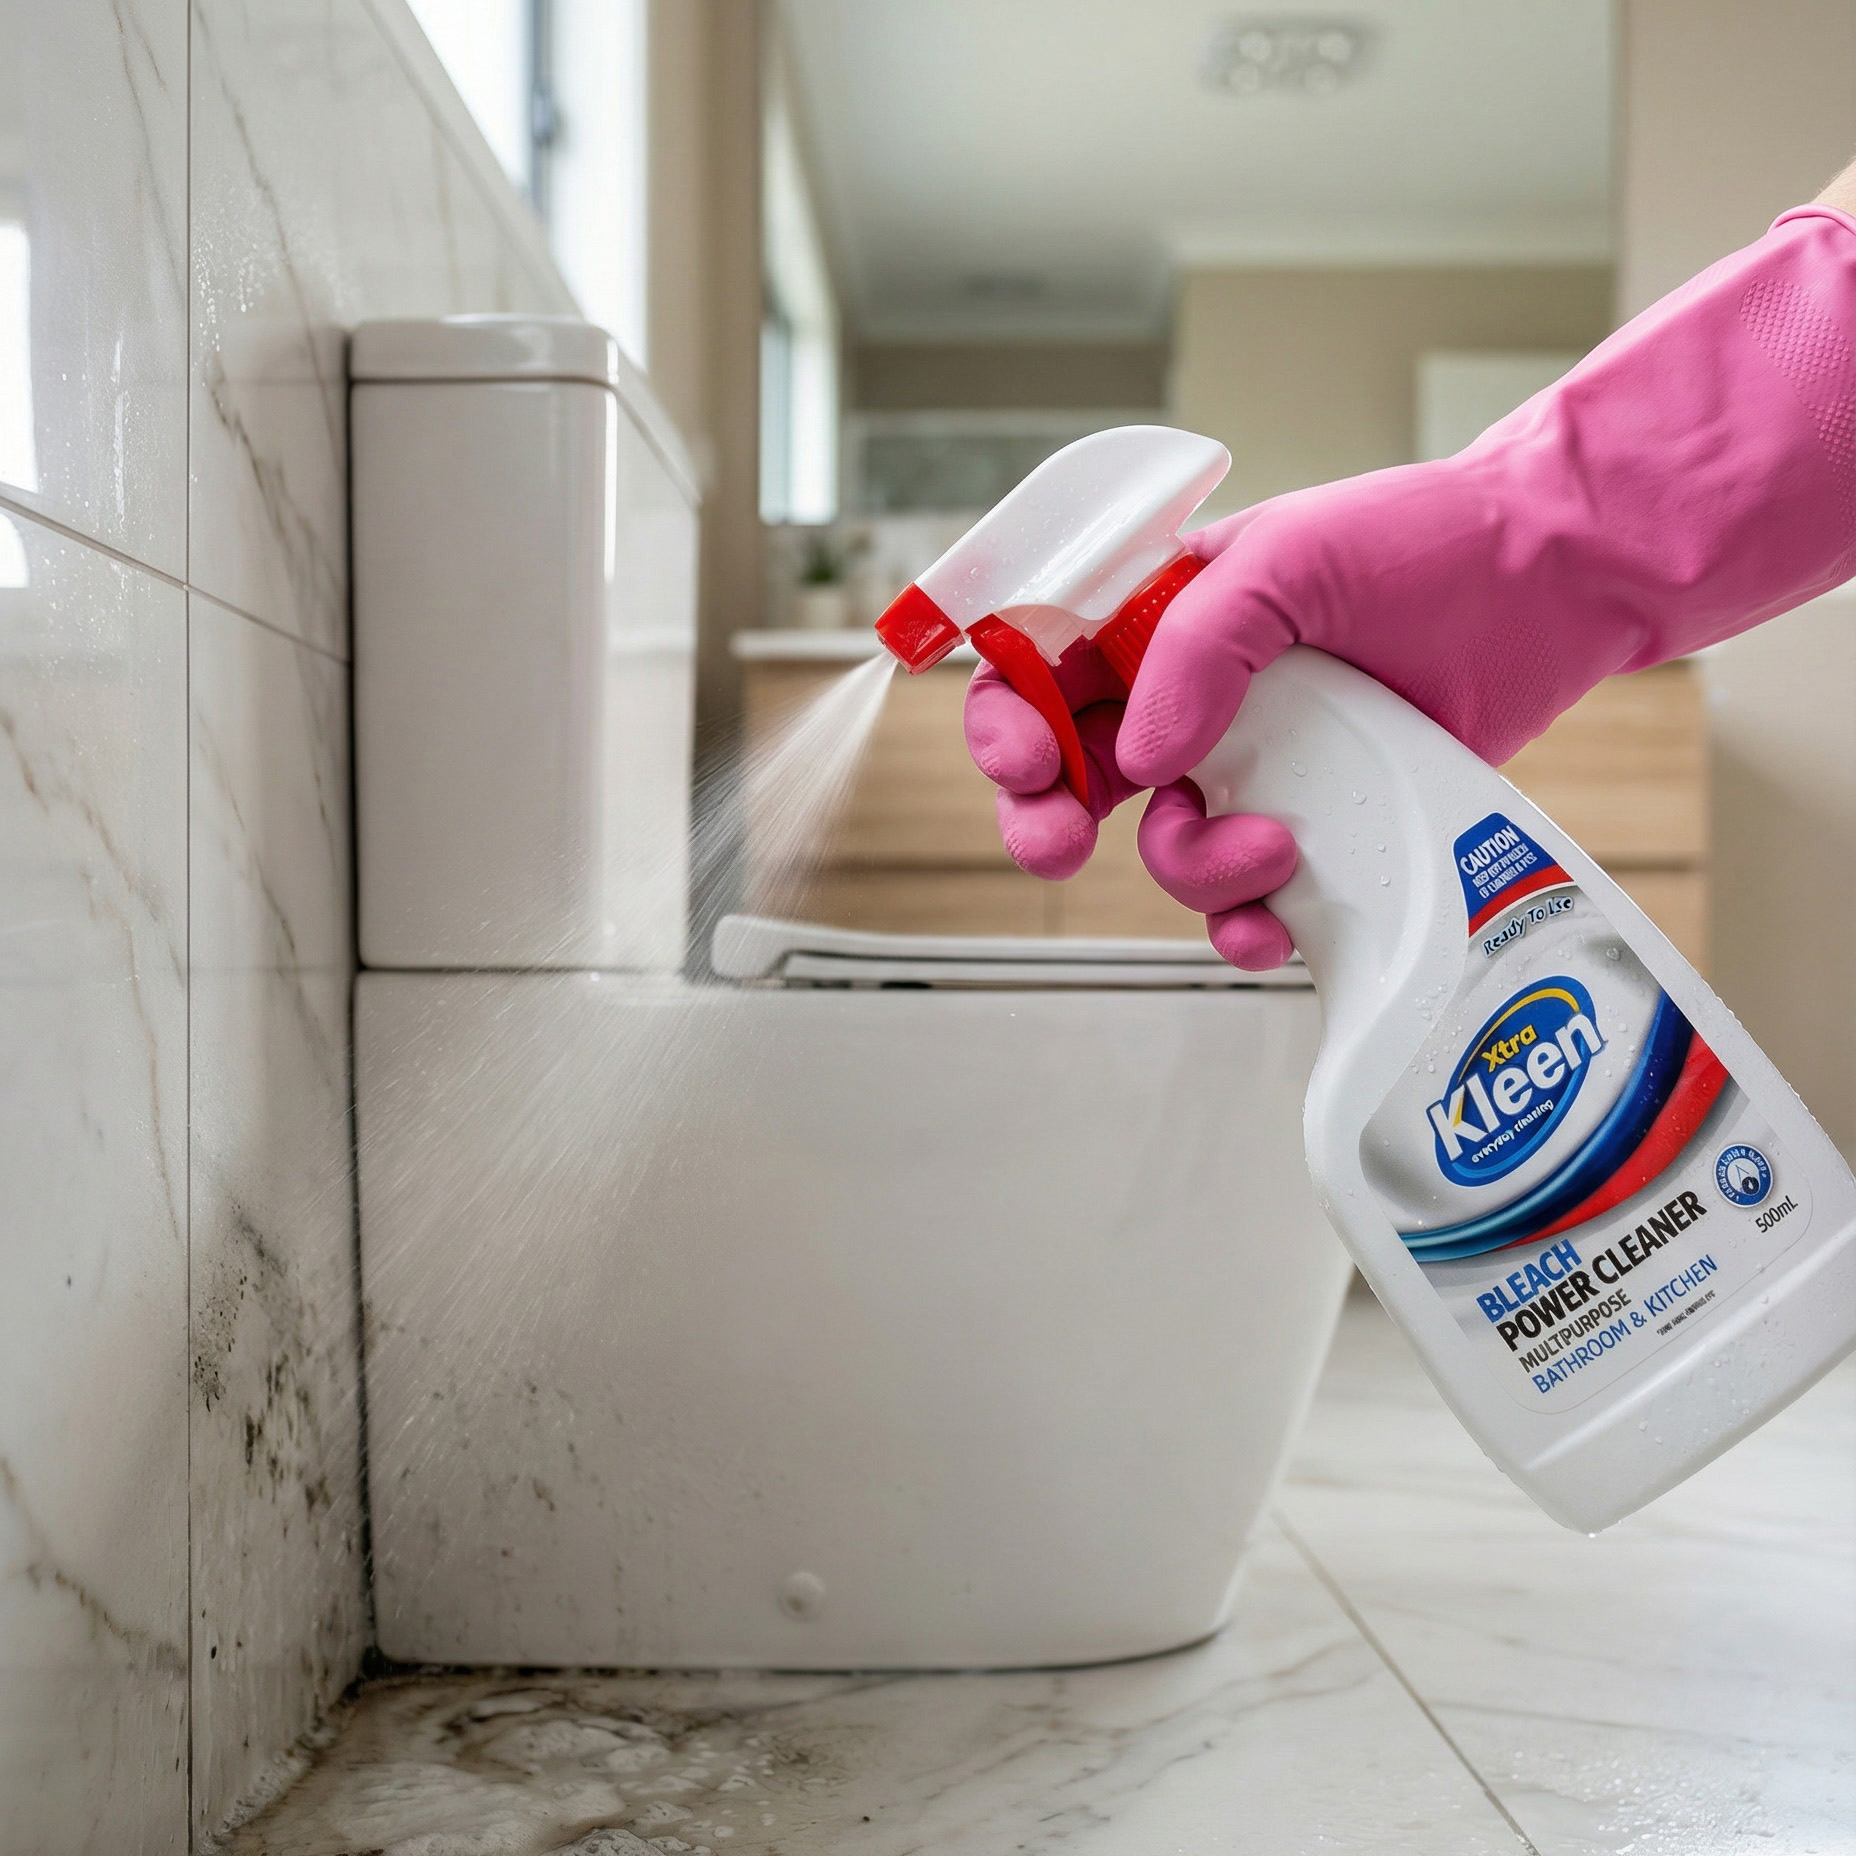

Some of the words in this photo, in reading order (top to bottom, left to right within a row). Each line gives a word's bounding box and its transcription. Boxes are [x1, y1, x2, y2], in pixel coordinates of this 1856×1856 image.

[1460, 825, 1520, 876] CAUTION
[1429, 1013, 1602, 1161] Kleen
[1482, 1025, 1538, 1073] Xtra
[1755, 1195, 1798, 1233] 500mL
[1476, 1239, 1582, 1323] BLEACH
[1496, 1270, 1600, 1352] POWER
[1592, 1190, 1708, 1284] CLEANER
[1532, 1319, 1631, 1394] BATHROOM
[1629, 1311, 1647, 1328] &
[1643, 1254, 1718, 1317] KITCHEN
